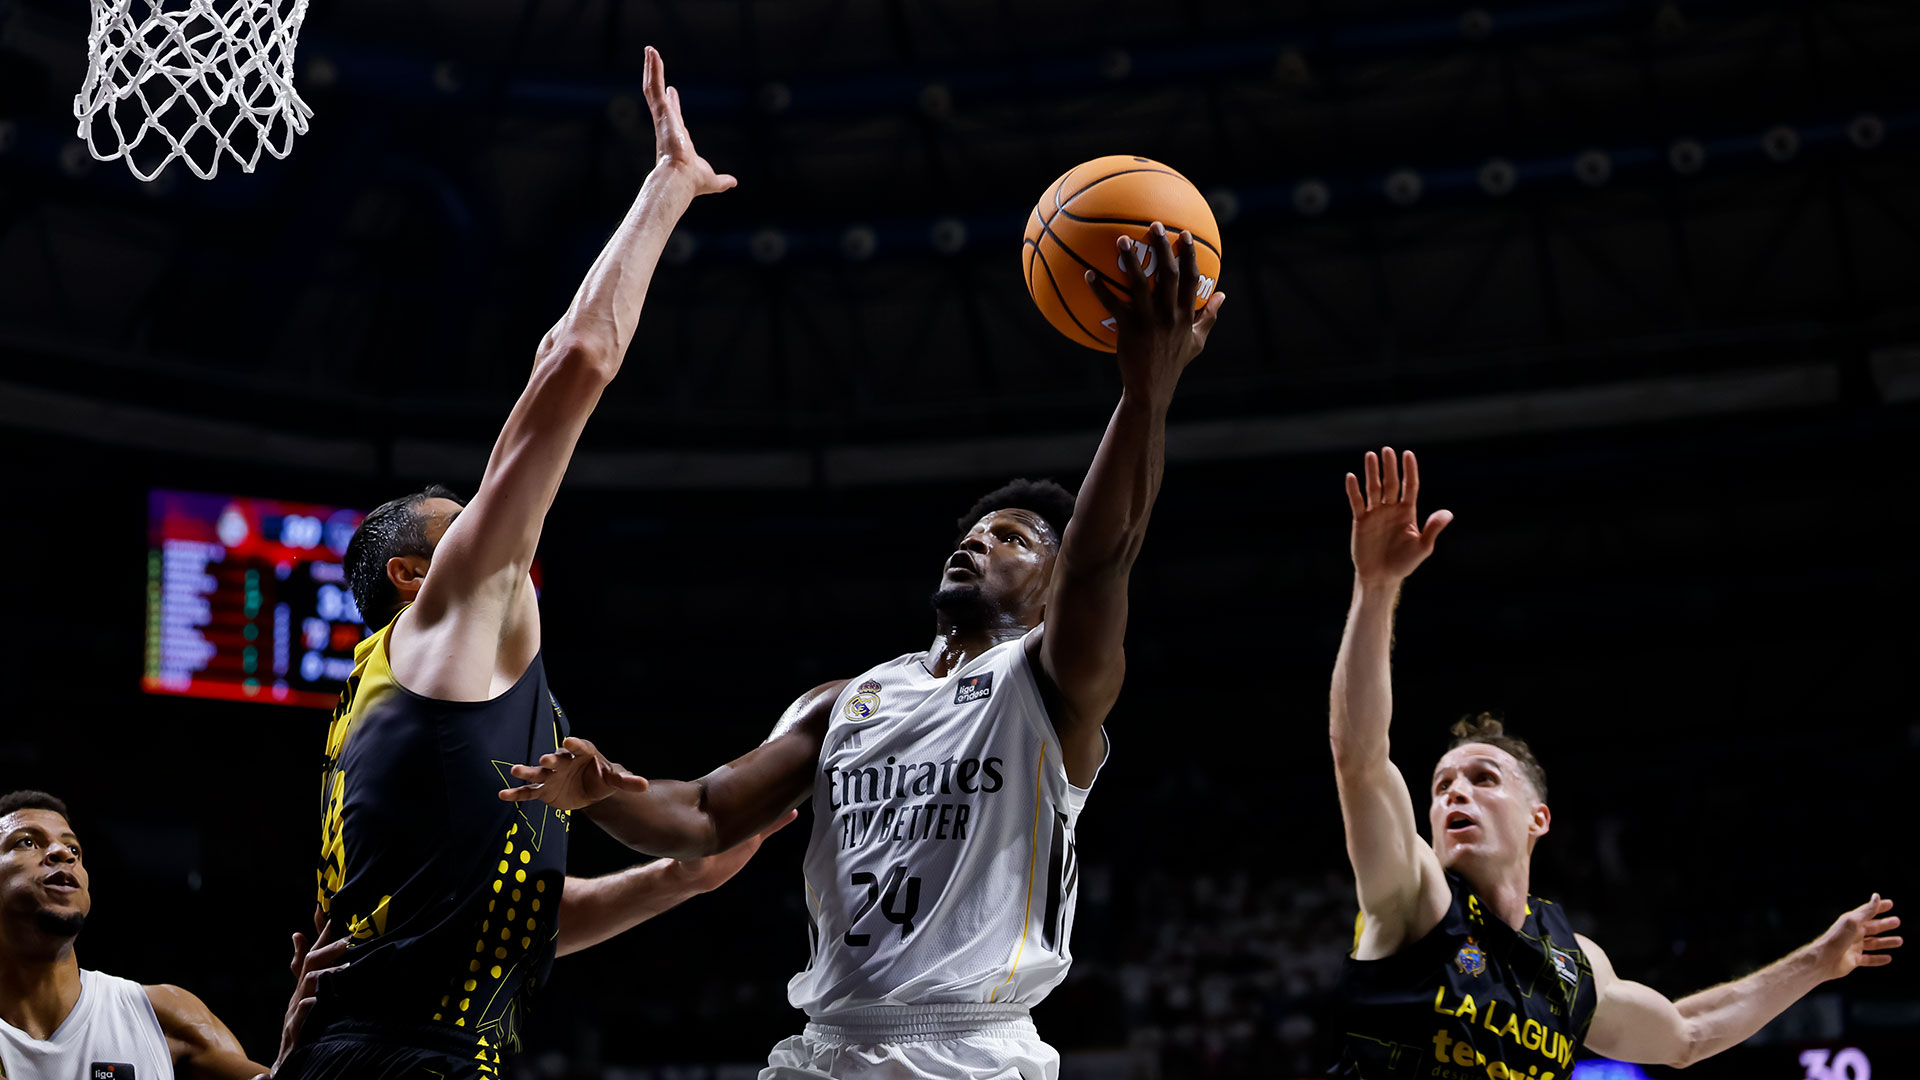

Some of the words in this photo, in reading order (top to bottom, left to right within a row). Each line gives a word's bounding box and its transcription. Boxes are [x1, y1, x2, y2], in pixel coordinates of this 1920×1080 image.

[824, 756, 1004, 813] Emirates
[842, 811, 875, 850] FLY
[878, 804, 970, 843] BETTER
[843, 866, 922, 947] 24
[1434, 985, 1477, 1024] LA
[95, 1069, 113, 1080] liga
